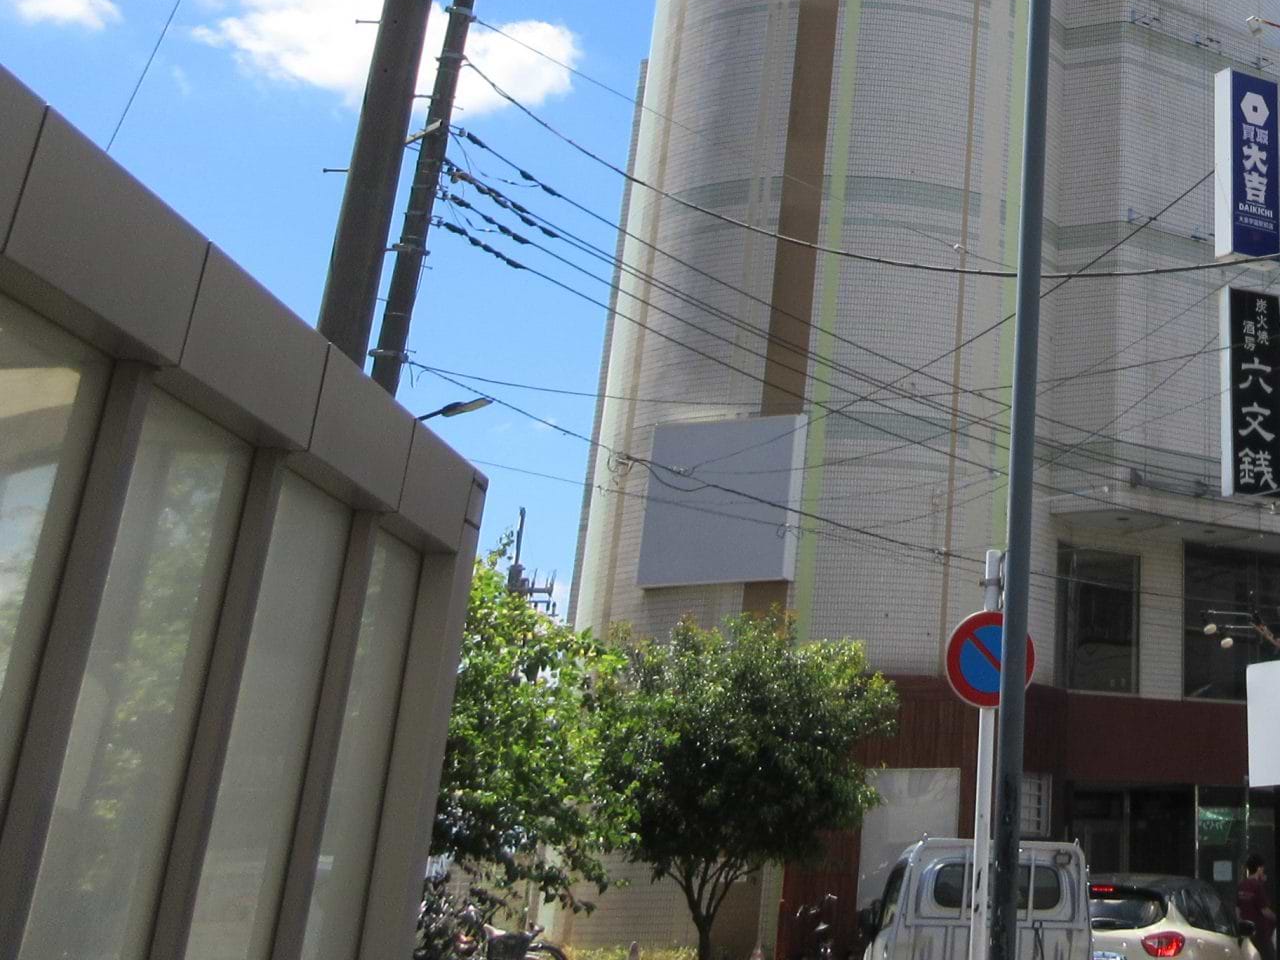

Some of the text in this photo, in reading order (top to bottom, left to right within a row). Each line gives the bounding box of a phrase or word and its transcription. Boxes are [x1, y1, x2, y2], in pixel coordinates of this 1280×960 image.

[1242, 143, 1269, 204] 大吉
[1238, 202, 1273, 218] DAIKICHI
[1255, 298, 1270, 345] 炭火焼
[1238, 357, 1278, 490] 六文銭
